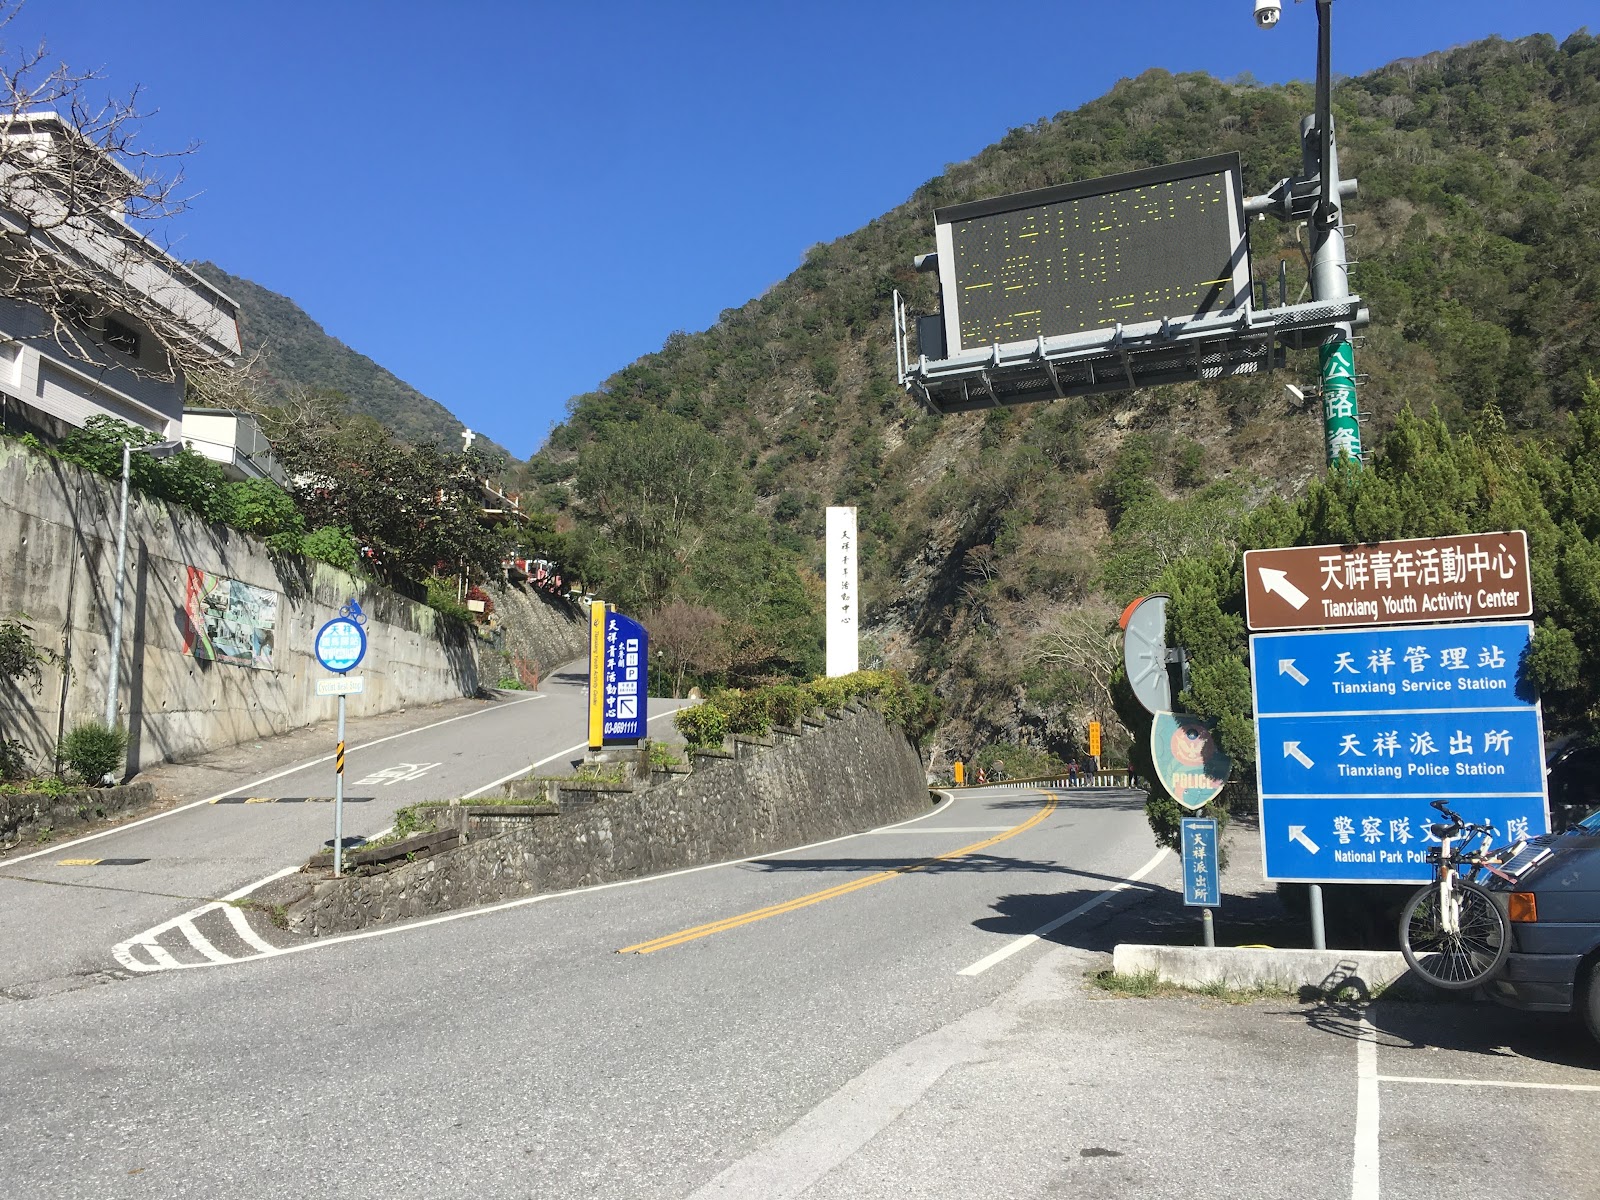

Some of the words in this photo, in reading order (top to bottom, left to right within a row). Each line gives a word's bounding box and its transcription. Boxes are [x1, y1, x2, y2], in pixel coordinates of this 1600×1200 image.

[1319, 543, 1517, 592] 天祥青年活動中心
[1322, 597, 1379, 621] Tianxiang
[1382, 594, 1417, 614] Youth
[1422, 590, 1472, 614] Activity
[1477, 588, 1520, 608] Center
[330, 624, 352, 635] 天祥
[605, 619, 619, 718] 天祥青年活動中心
[1333, 645, 1506, 675] 天祥管理站
[1332, 681, 1396, 695] Tianxiang
[1402, 678, 1452, 692] Service
[1458, 677, 1507, 690] Station
[604, 721, 637, 735] 03-8691111
[1338, 729, 1513, 758] 天祥派出所
[1337, 764, 1402, 779] Tianxiang
[1408, 763, 1450, 777] Police
[1455, 762, 1505, 776] Station
[1191, 832, 1209, 903] 天祥派出所
[1334, 850, 1376, 863] National
[1380, 850, 1404, 863] Park
[1407, 850, 1431, 863] Poli
